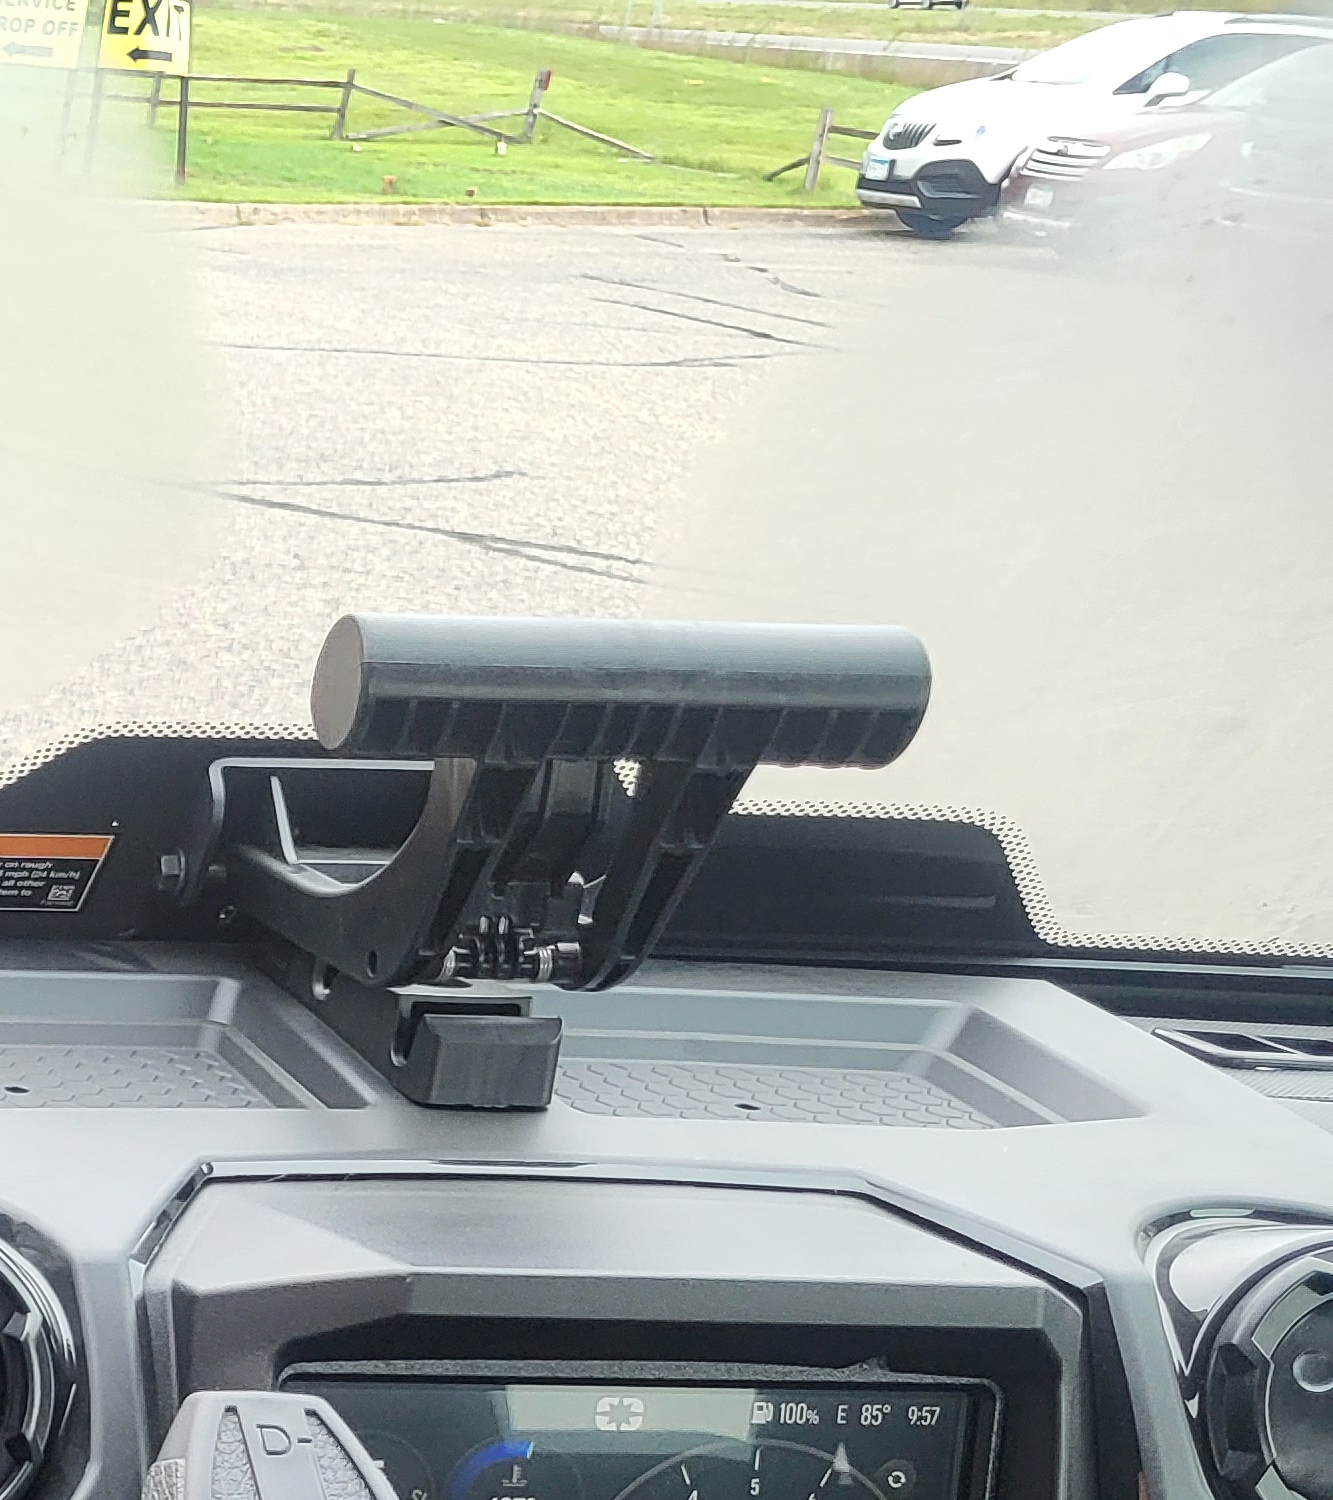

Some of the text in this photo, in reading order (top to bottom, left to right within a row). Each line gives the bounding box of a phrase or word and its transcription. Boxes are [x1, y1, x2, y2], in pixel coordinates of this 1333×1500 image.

[42, 20, 80, 37] OFF
[779, 1402, 820, 1425] 100%
[836, 1404, 849, 1425] E
[908, 1406, 941, 1426] 9:57
[749, 1478, 760, 1496] 5
